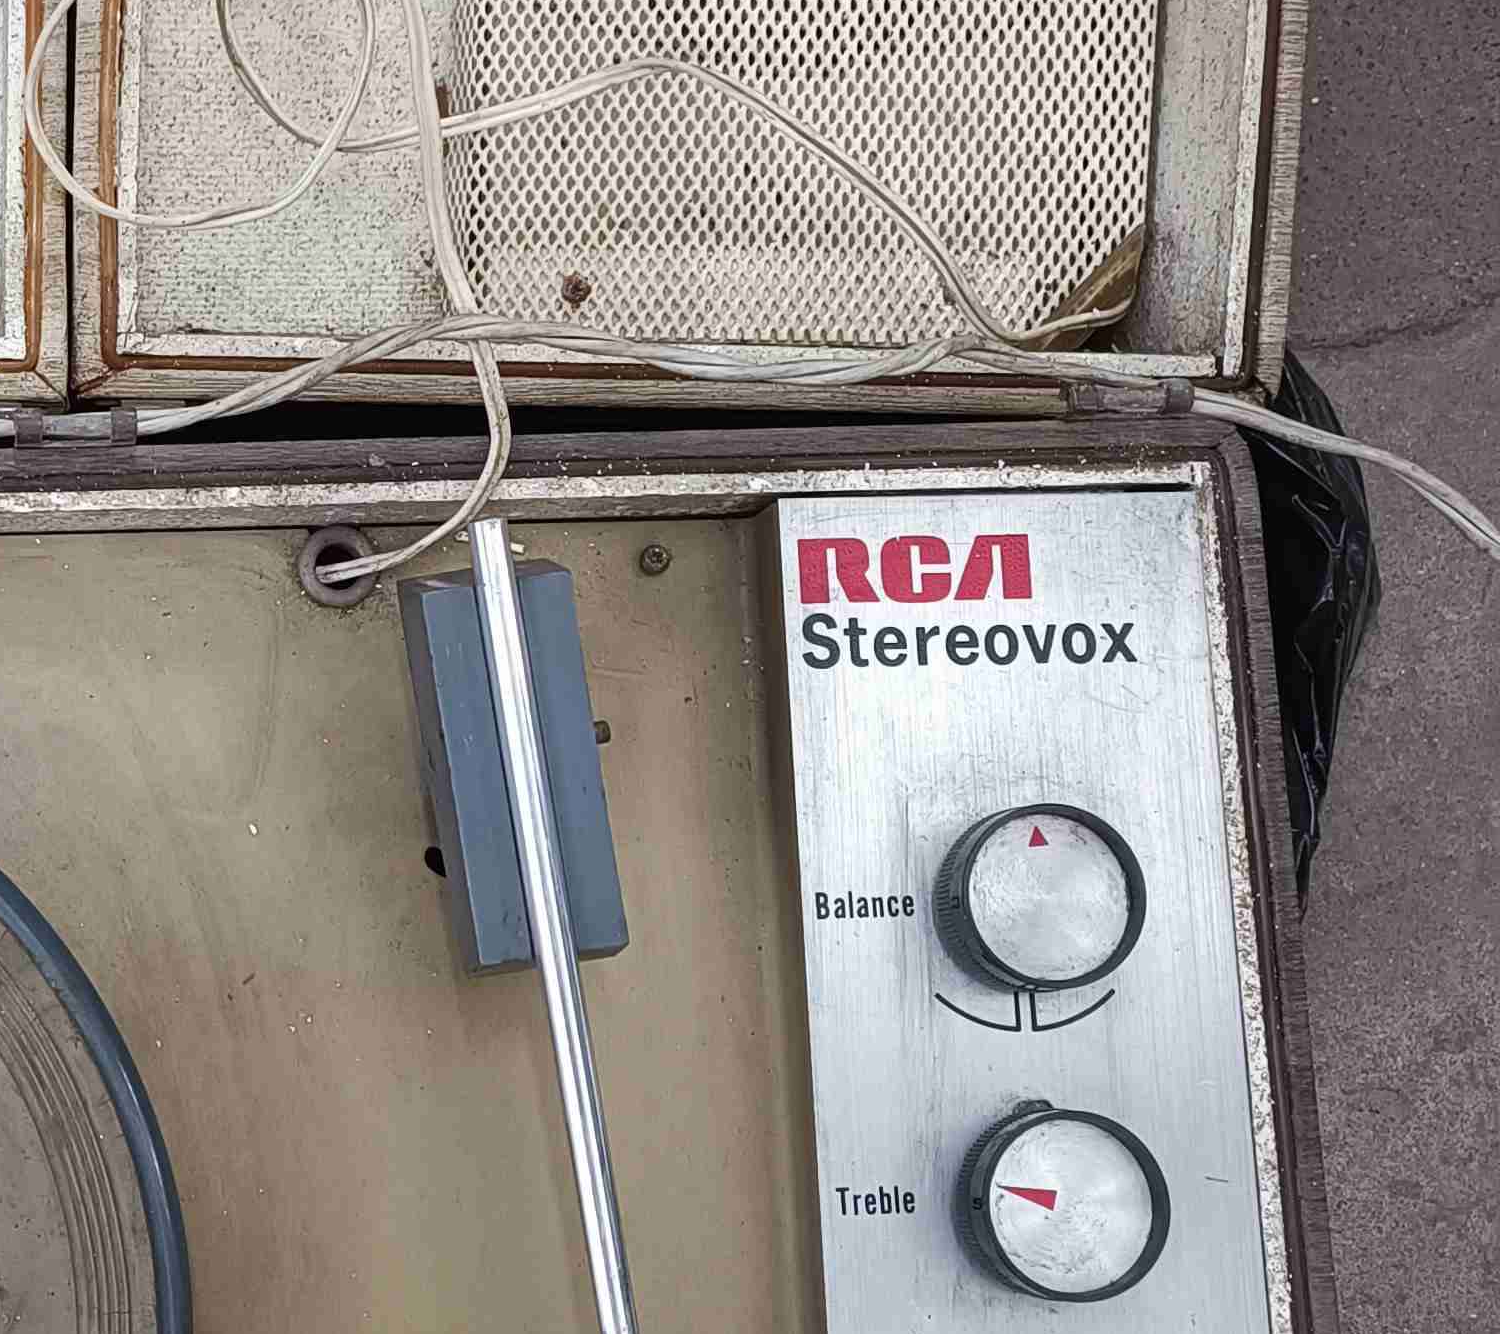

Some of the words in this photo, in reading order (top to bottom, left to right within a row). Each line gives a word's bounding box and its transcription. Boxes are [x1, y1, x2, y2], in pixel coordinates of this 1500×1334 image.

[797, 534, 1032, 604] RCA
[802, 613, 1138, 669] Stereovox
[815, 891, 915, 920] Balance
[836, 1186, 915, 1216] Treble
